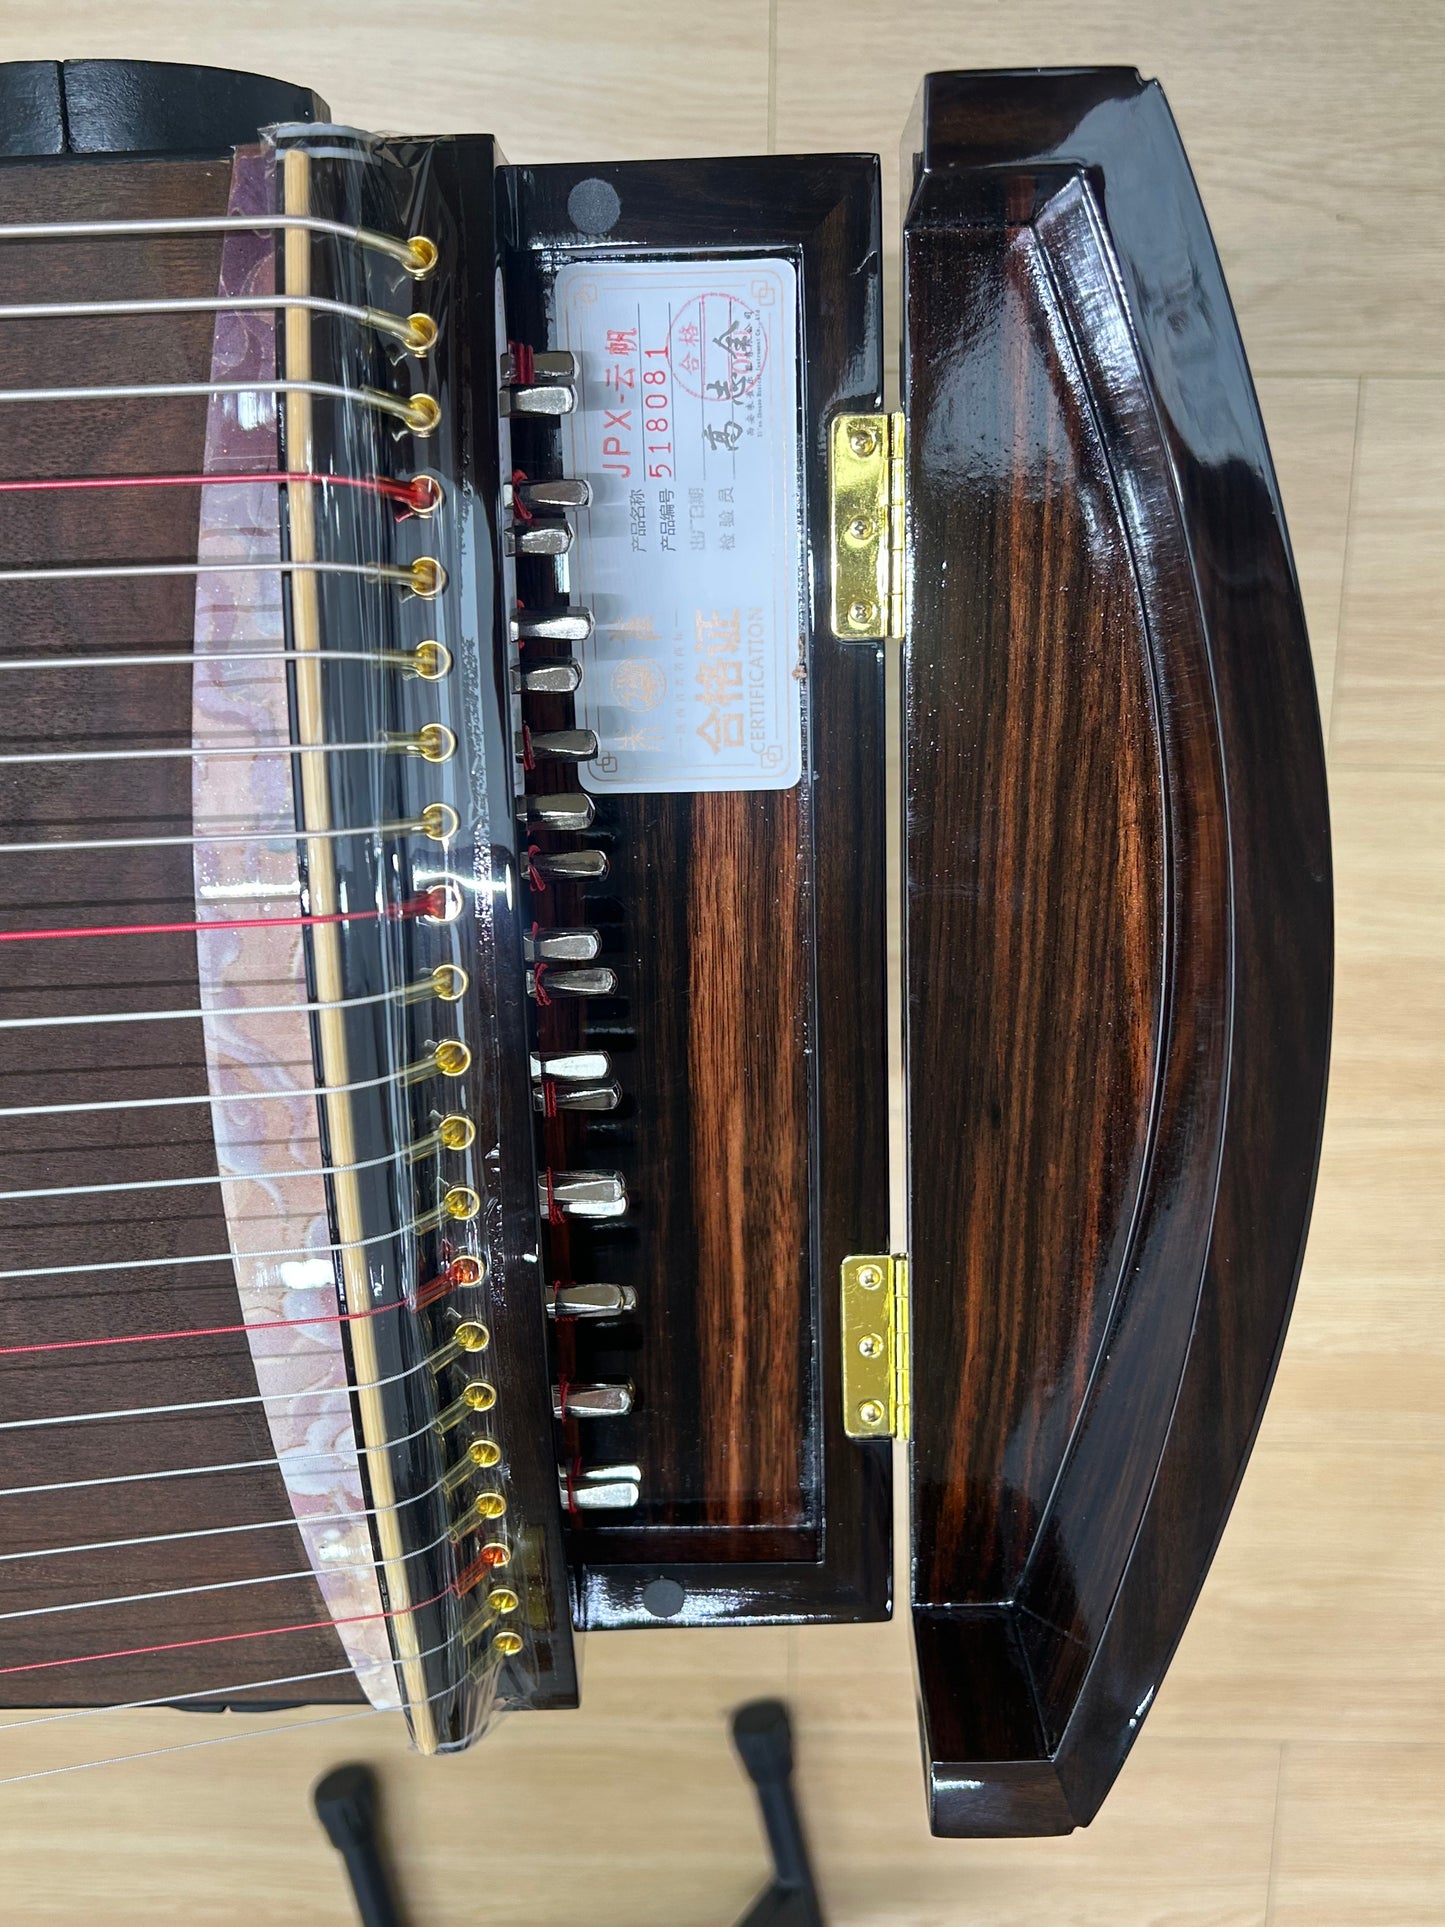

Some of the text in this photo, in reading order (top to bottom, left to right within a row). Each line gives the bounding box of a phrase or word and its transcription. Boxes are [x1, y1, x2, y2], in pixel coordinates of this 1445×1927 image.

[677, 321, 700, 376] 合格
[643, 345, 673, 479] 518081
[628, 488, 648, 553] 产品名称
[658, 487, 677, 553] 产品编号
[717, 486, 736, 552] 检验员
[693, 608, 745, 754] 合格证
[748, 607, 766, 755] CERTIFICATION
